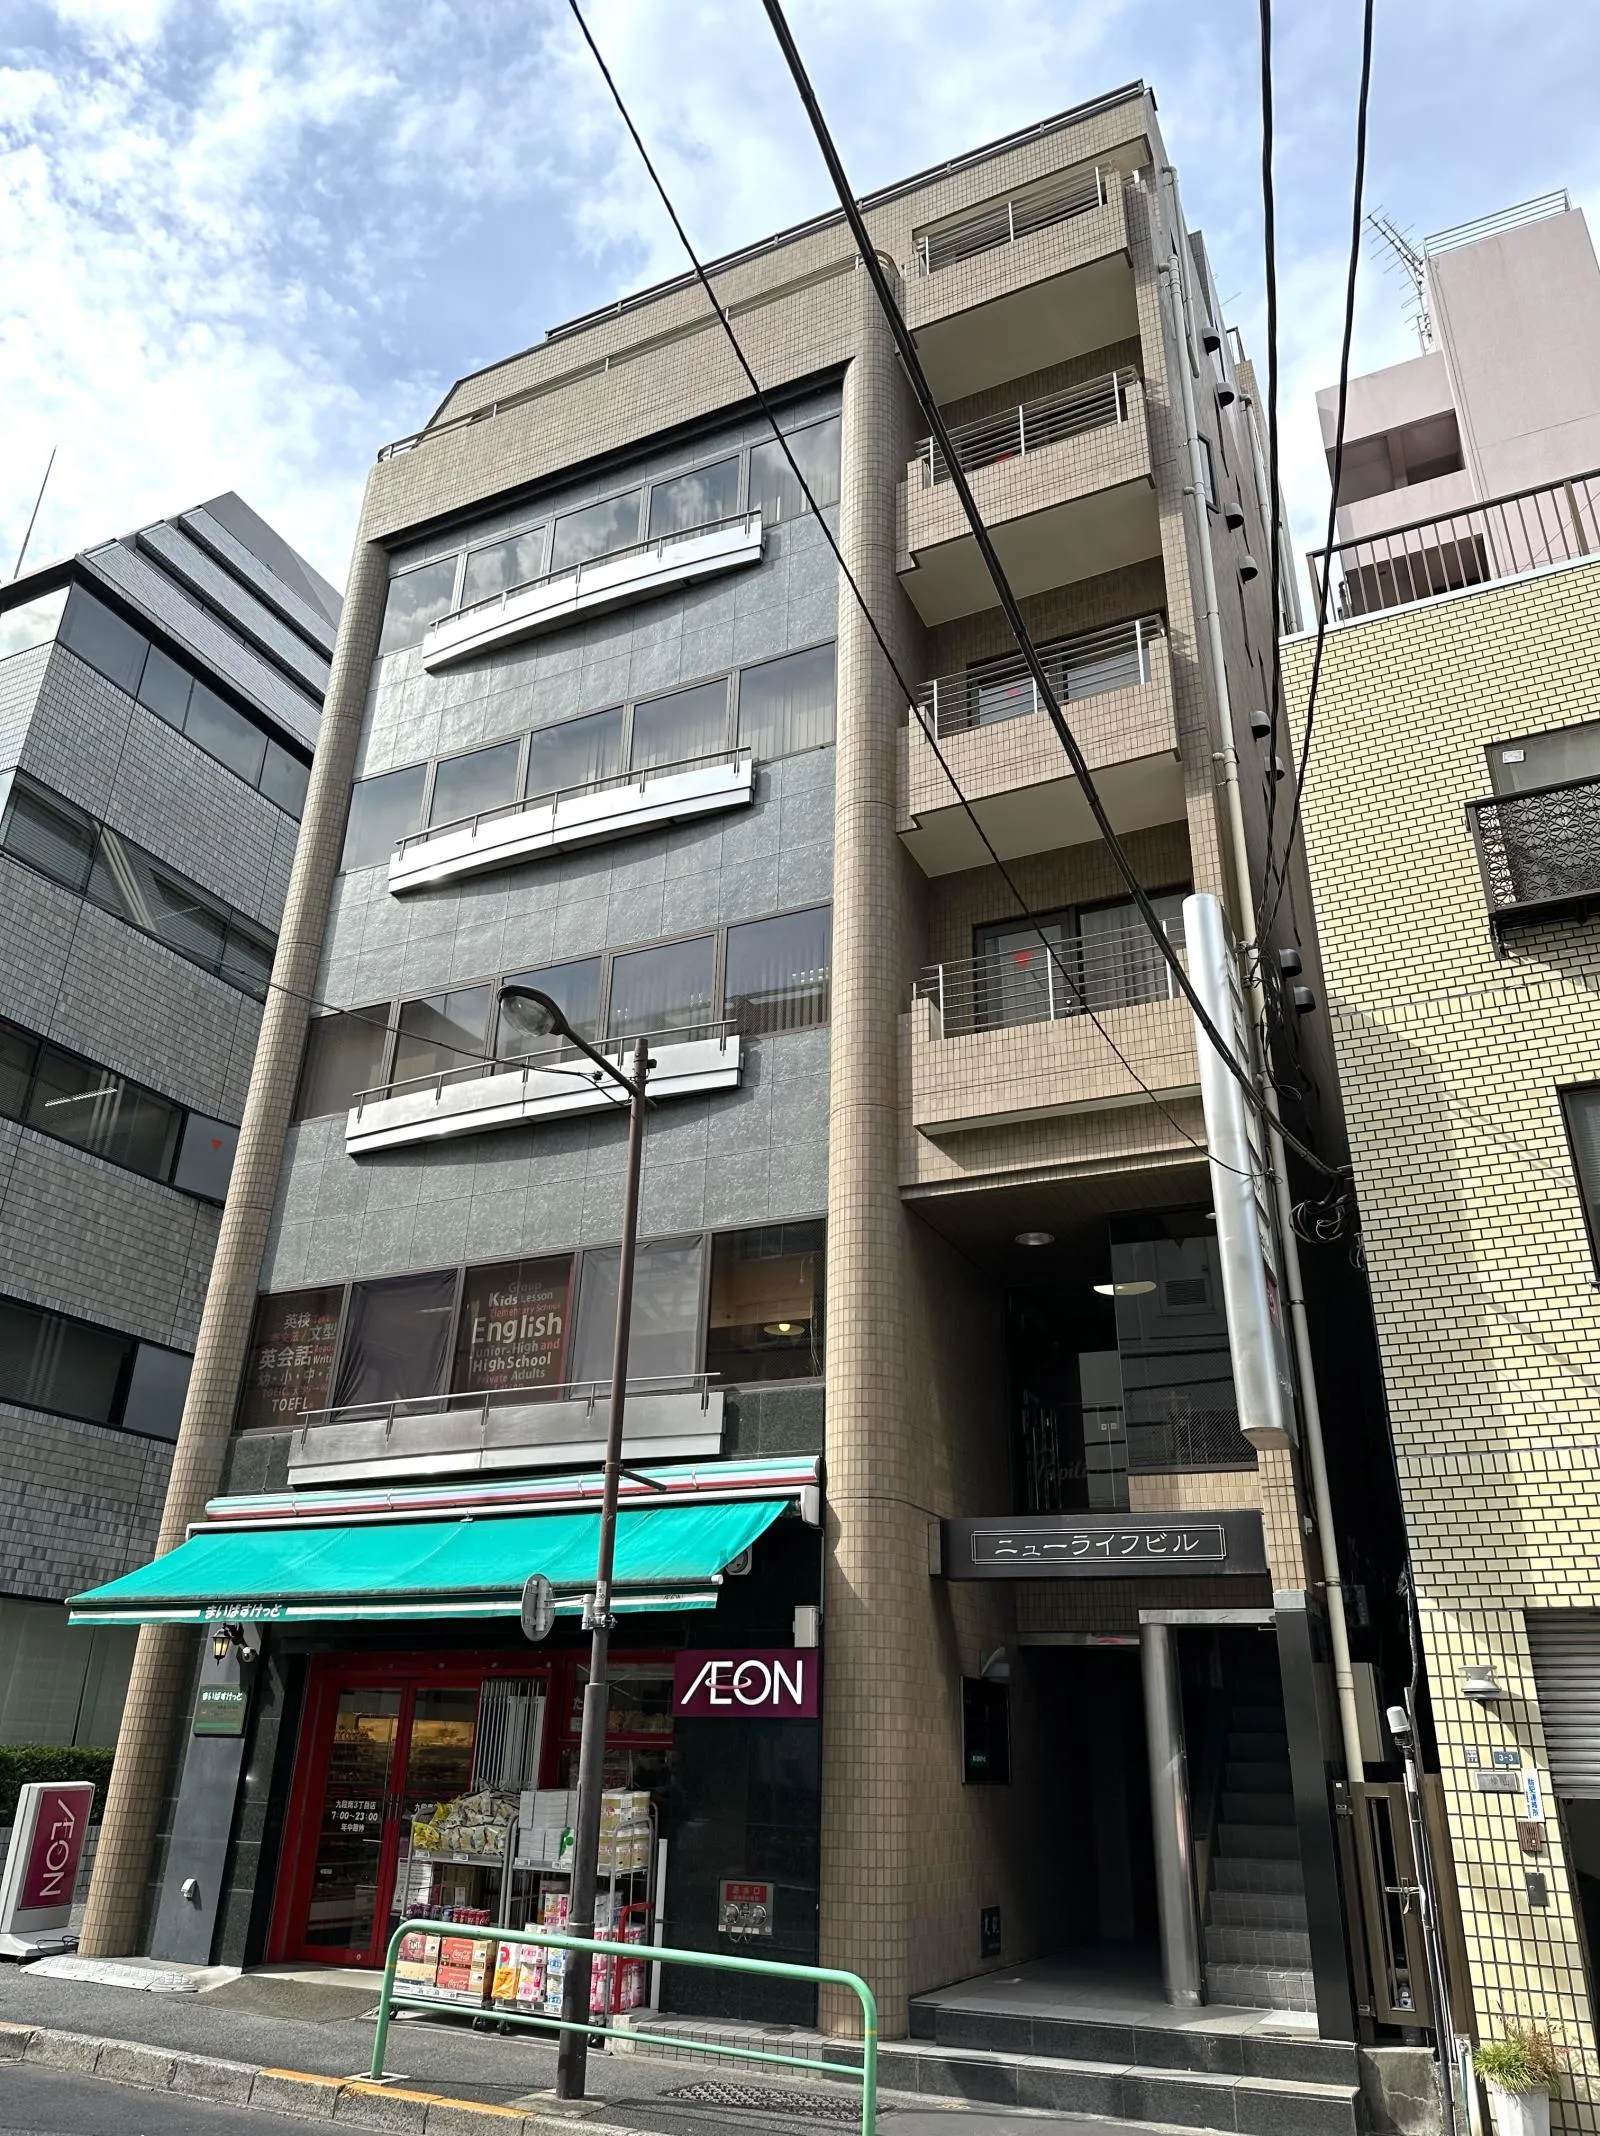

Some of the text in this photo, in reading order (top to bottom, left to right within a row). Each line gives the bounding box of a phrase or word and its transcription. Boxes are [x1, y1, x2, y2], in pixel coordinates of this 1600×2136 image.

[488, 1292, 518, 1308] Kids
[471, 1312, 562, 1344] English
[540, 1338, 560, 1350] and
[258, 1344, 314, 1370] 英会話
[472, 1351, 552, 1373] High School
[511, 1368, 546, 1381] Adults
[272, 1397, 308, 1412] TOEFL
[995, 1532, 1199, 1557] ニューライフビル
[204, 1603, 283, 1620] まいばすけっと
[202, 1691, 243, 1701] まいばすけっと
[1498, 1754, 1514, 1762] 3-3
